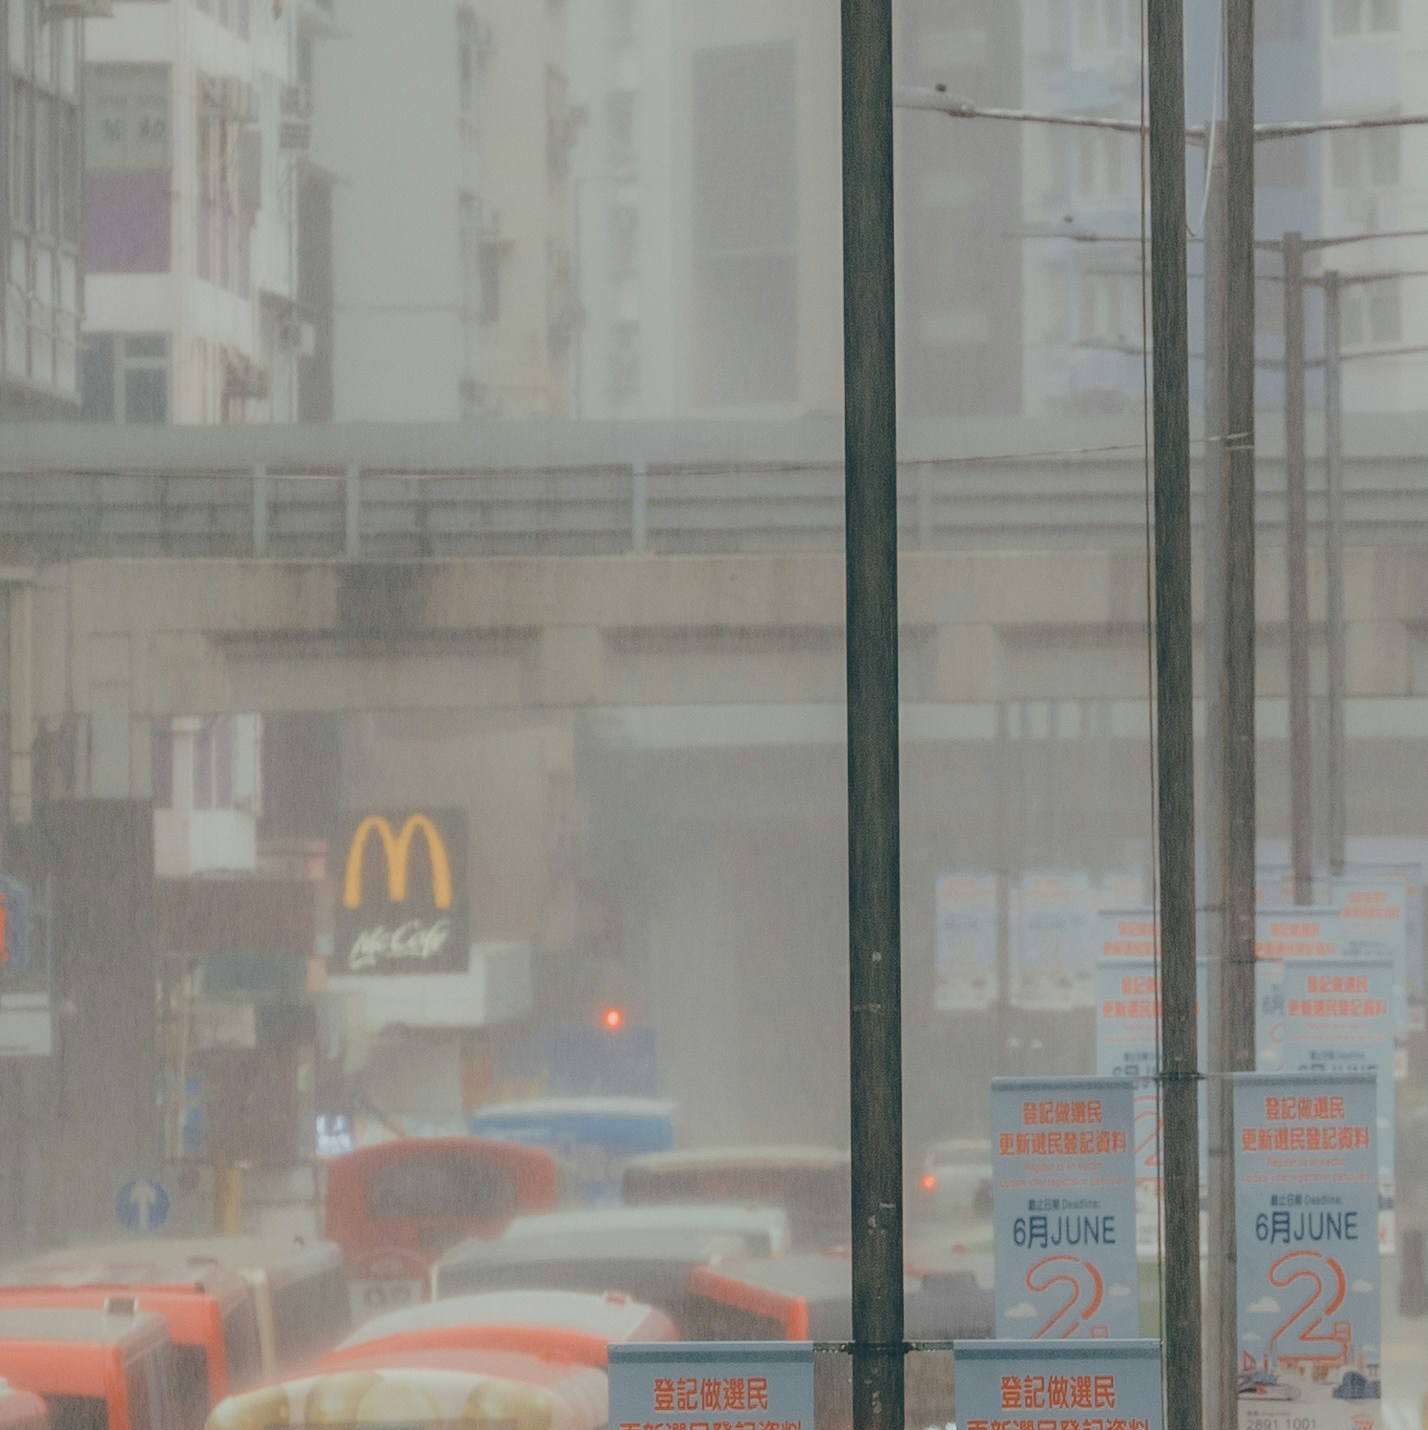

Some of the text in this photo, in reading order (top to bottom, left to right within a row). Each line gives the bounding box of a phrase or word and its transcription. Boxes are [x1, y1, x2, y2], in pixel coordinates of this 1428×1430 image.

[654, 1376, 769, 1411] 登記做選民
[1001, 1375, 1116, 1409] 登記做選民
